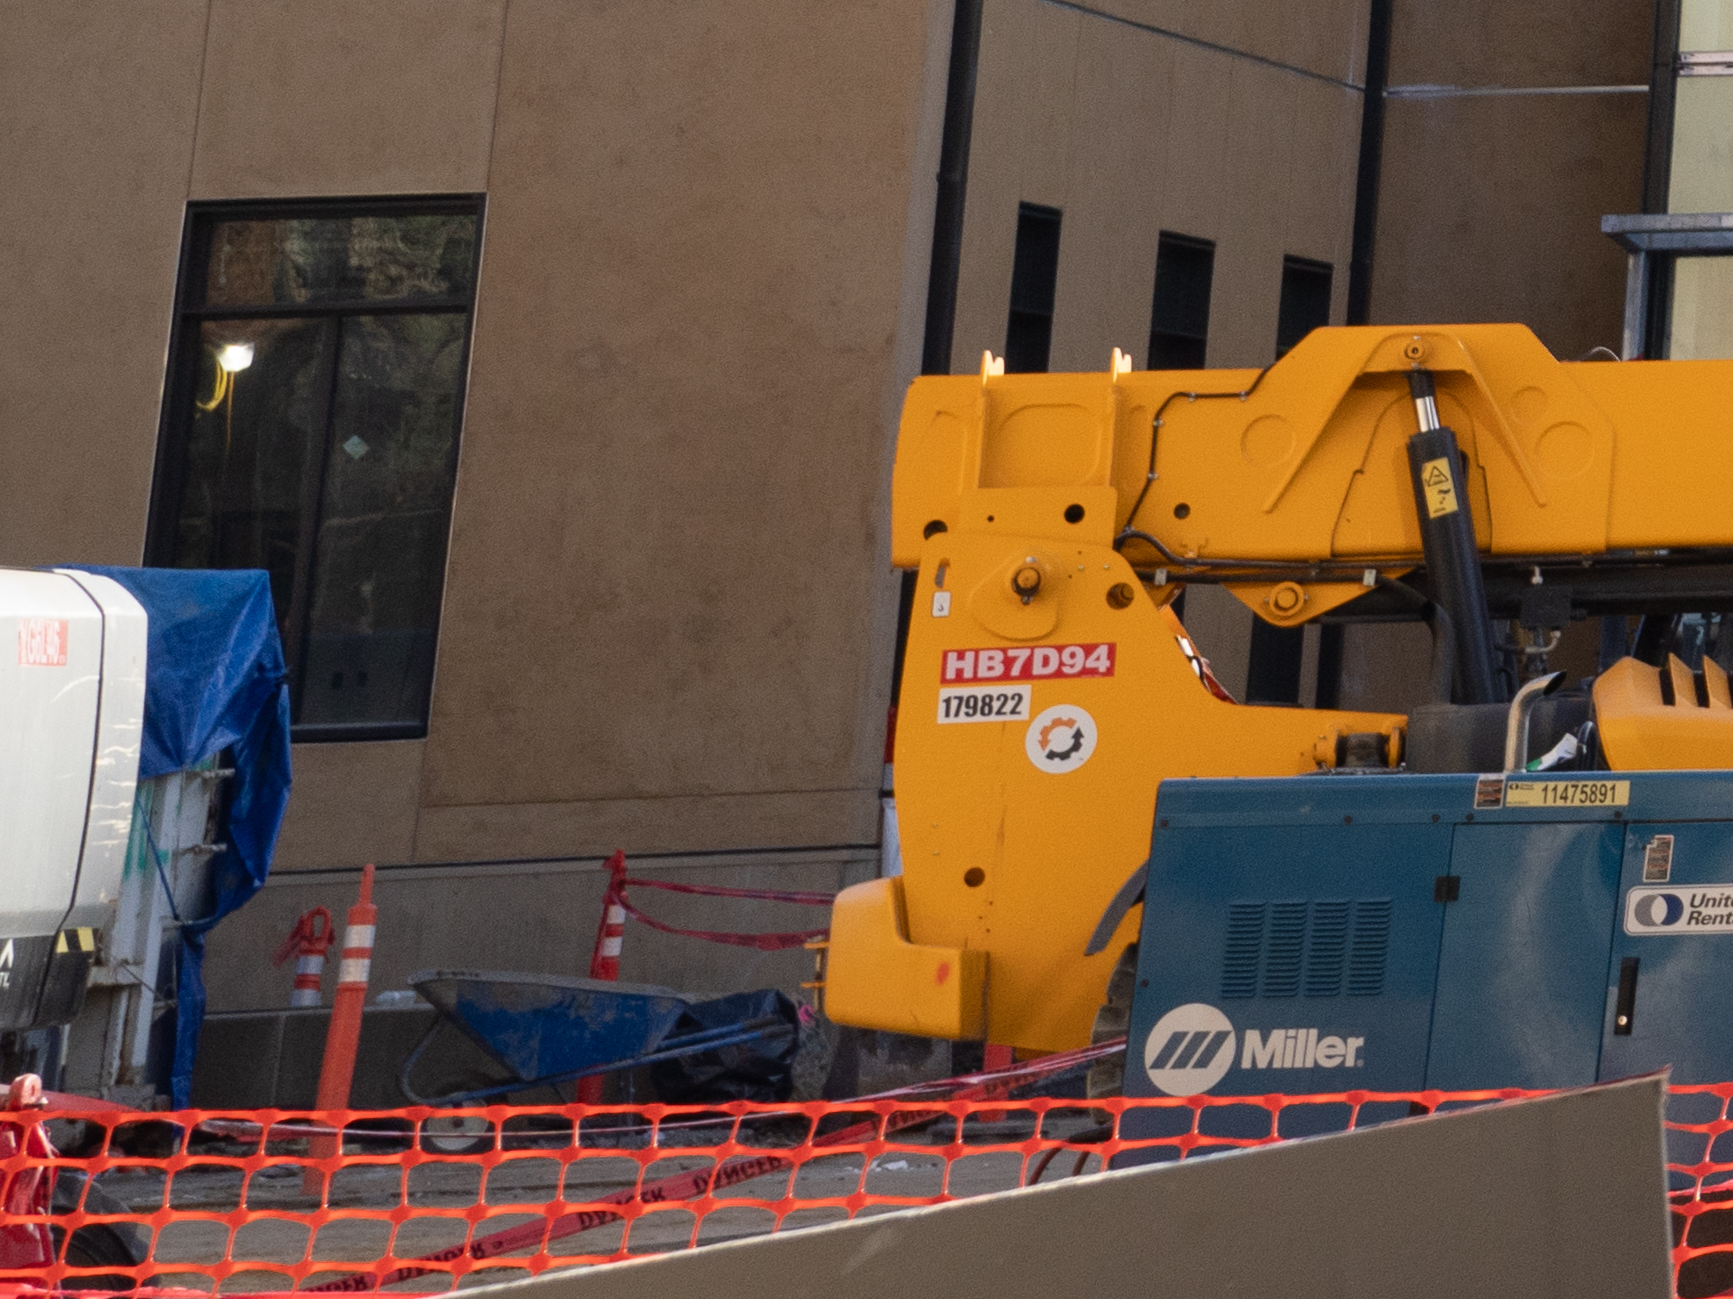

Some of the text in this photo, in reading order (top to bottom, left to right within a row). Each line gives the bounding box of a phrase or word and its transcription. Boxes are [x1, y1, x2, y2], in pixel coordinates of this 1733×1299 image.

[945, 644, 1111, 680] HB7D94
[942, 692, 1024, 718] 179822
[1541, 784, 1617, 805] 11475891
[1241, 1028, 1365, 1070] Miller
